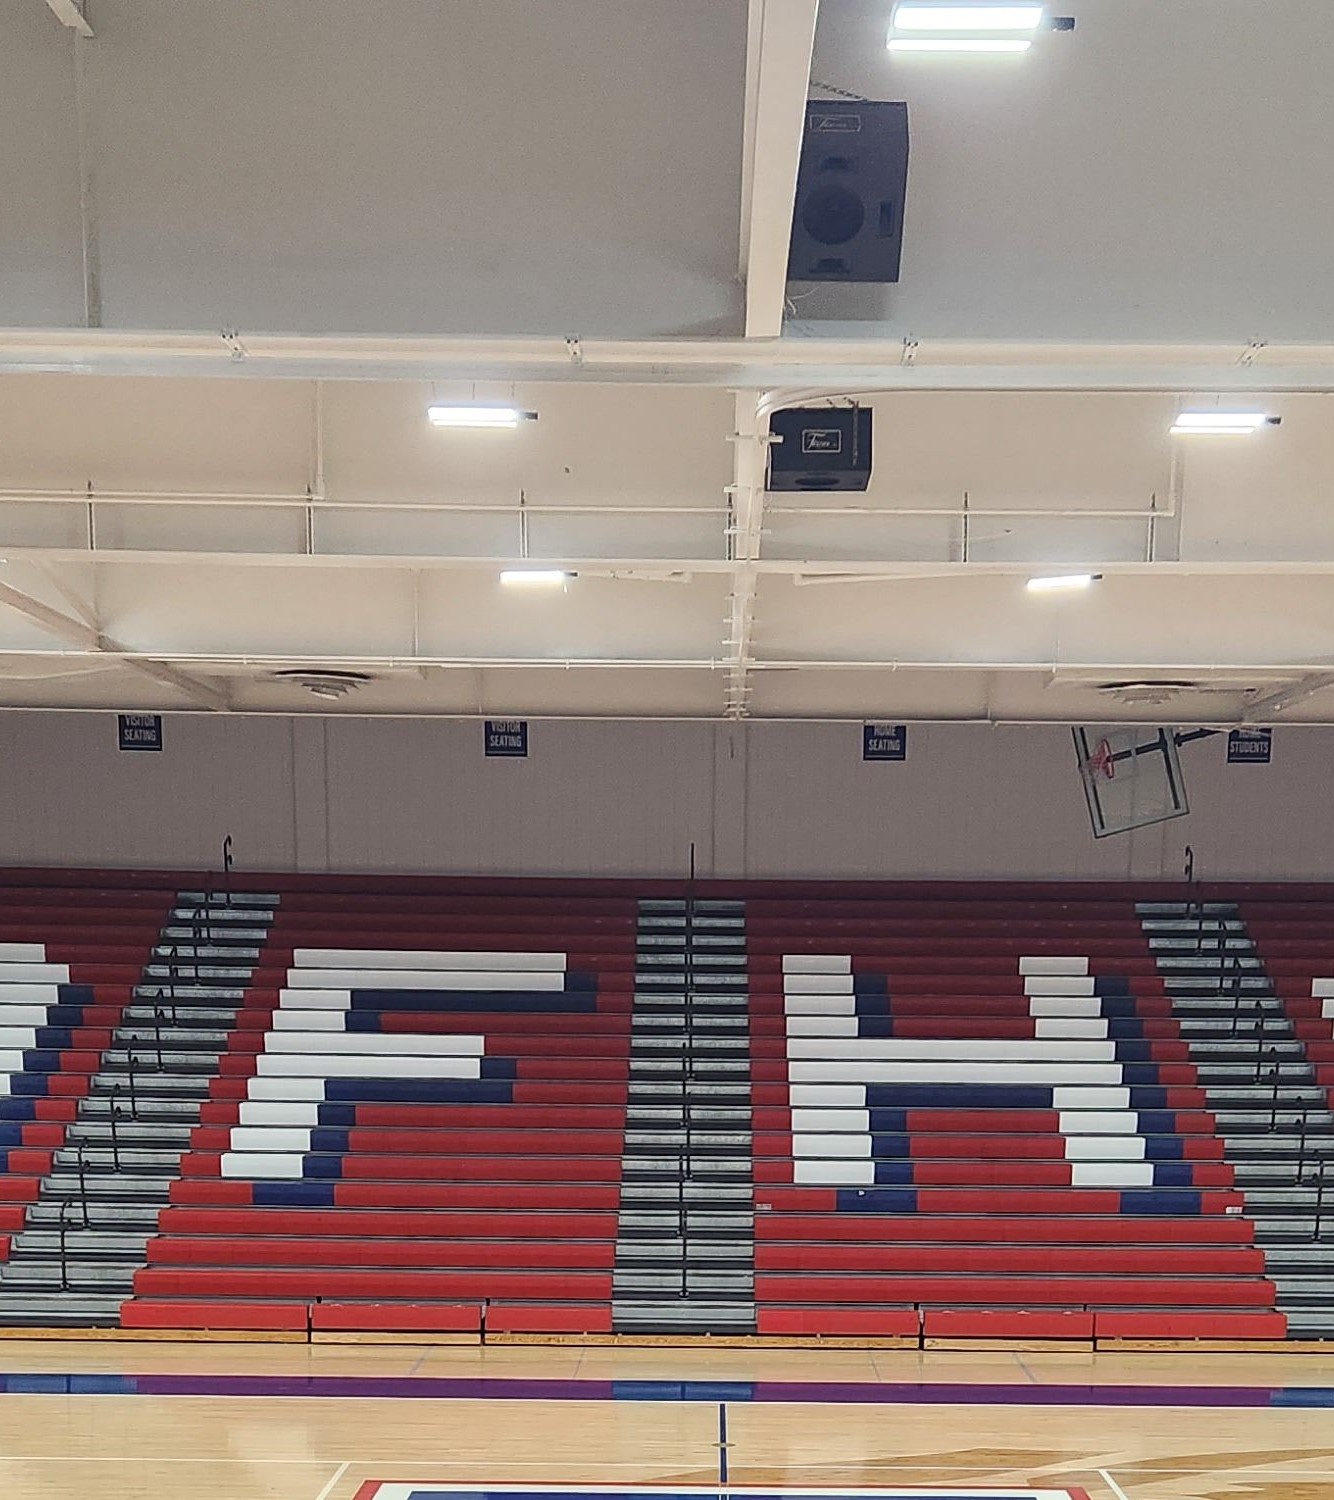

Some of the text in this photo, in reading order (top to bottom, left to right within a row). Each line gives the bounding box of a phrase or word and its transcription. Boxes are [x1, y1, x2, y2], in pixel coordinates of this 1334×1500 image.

[123, 728, 156, 742] SEATING
[490, 734, 522, 748] SEATING
[868, 738, 901, 752] SEATING
[1230, 740, 1269, 754] STUDENTS
